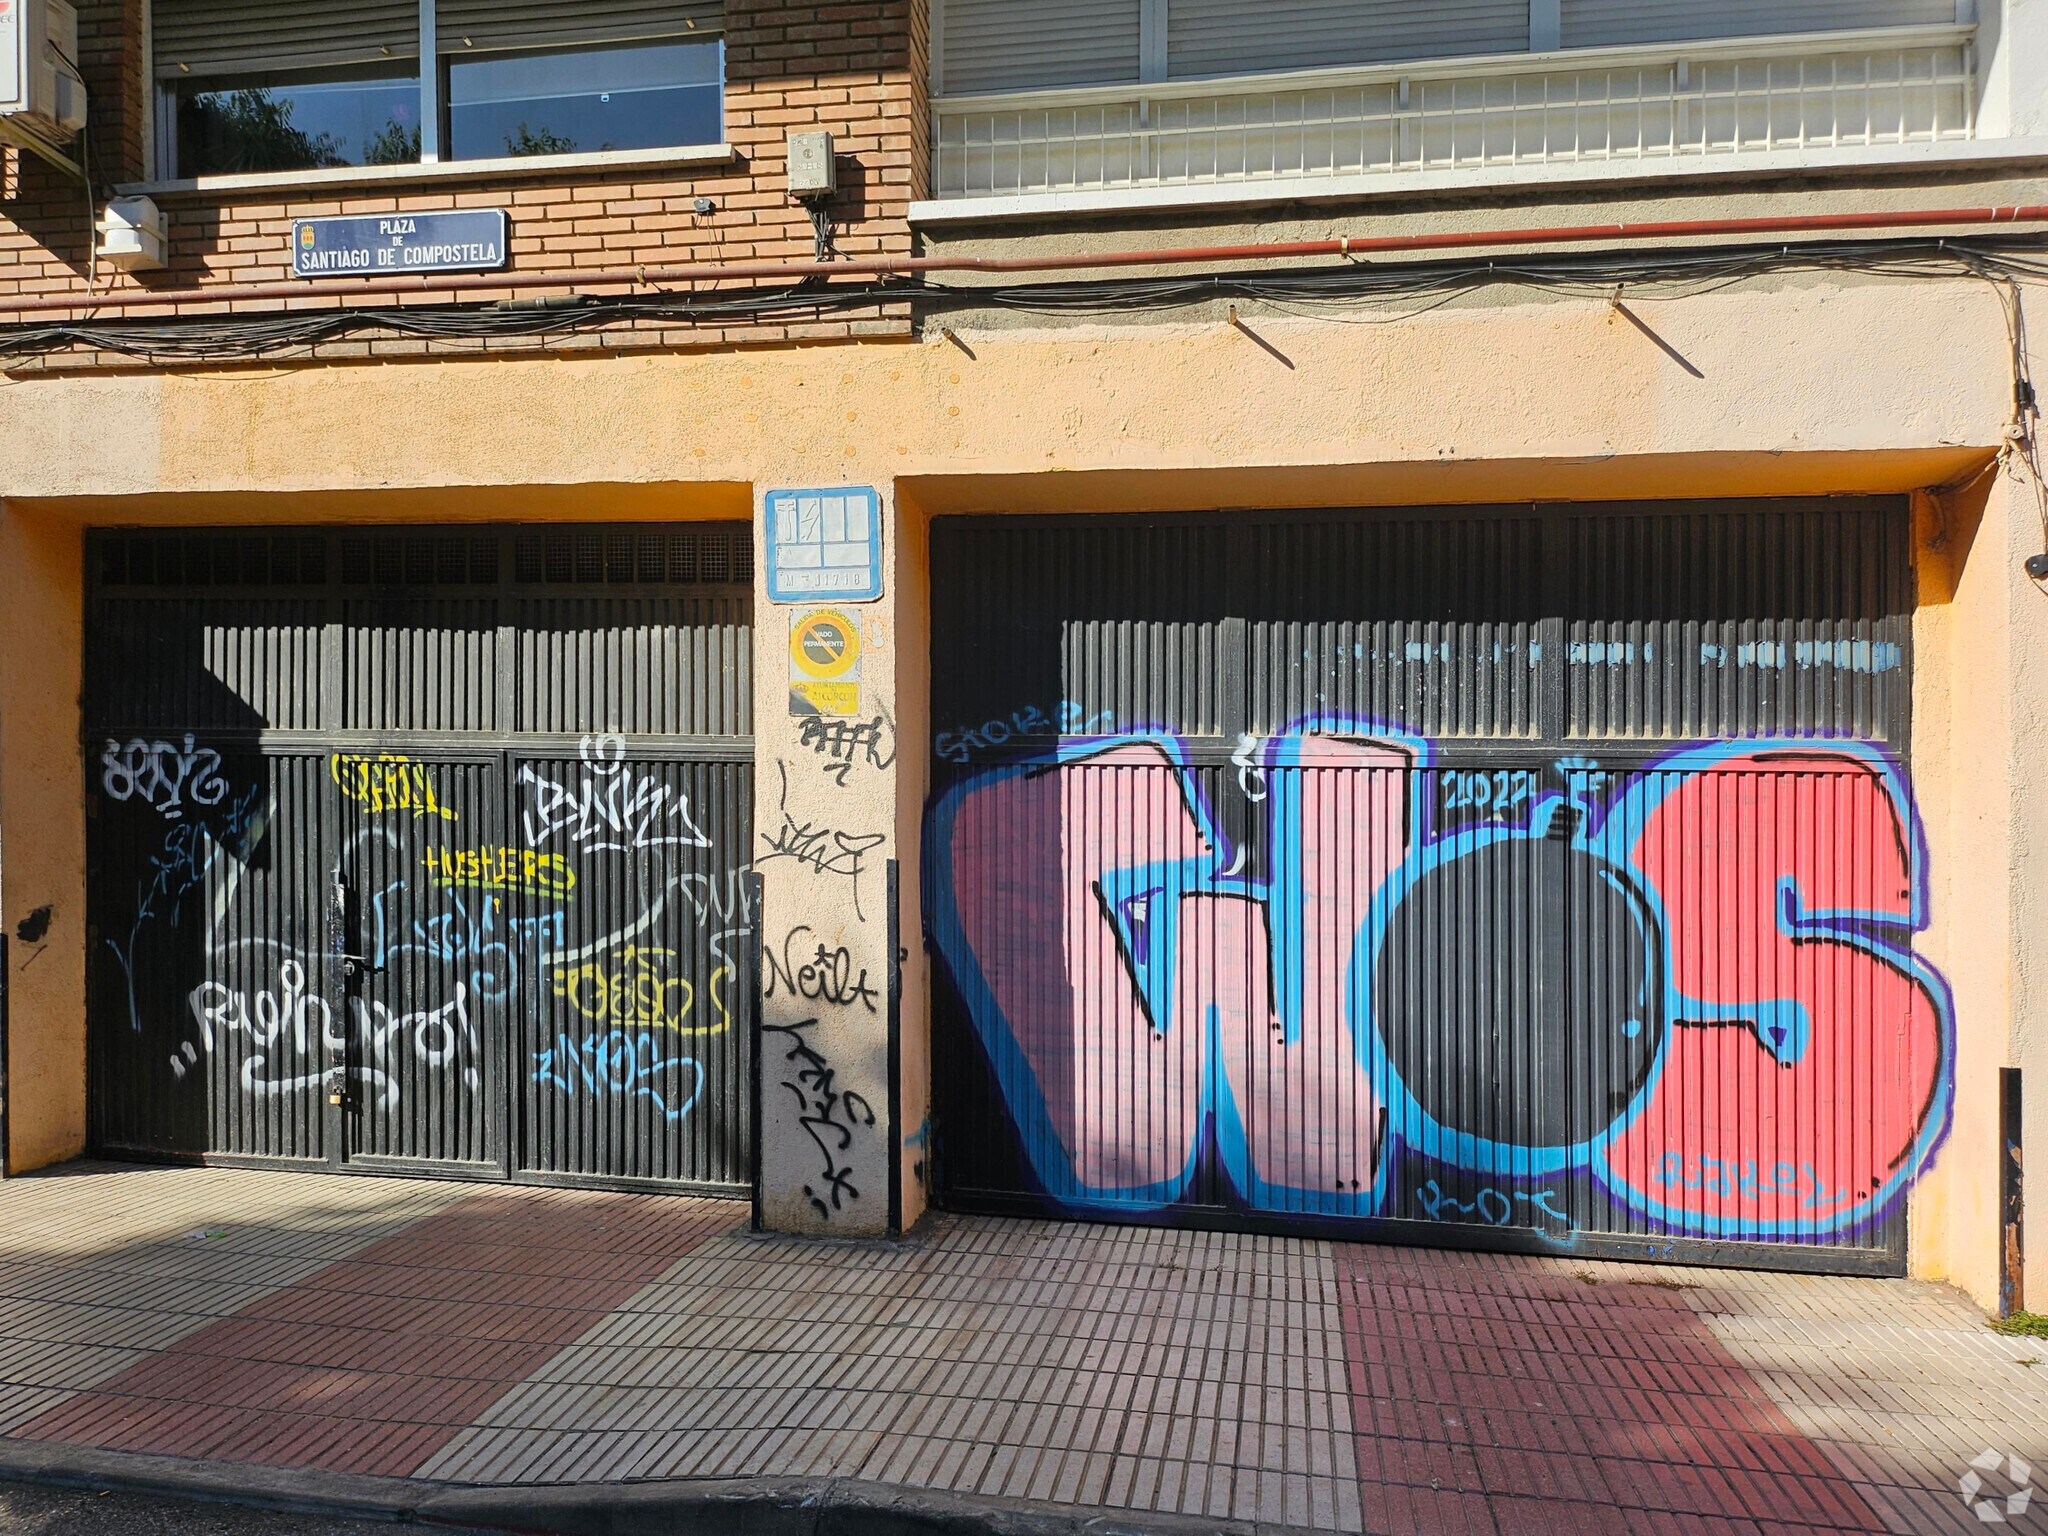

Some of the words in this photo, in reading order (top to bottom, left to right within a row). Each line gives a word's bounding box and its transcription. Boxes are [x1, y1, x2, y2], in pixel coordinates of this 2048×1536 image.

[380, 219, 416, 235] PLAZA
[392, 236, 404, 247] DE
[301, 249, 370, 270] SANTIAGO
[378, 248, 396, 266] DE
[404, 242, 497, 265] COMPOSTELA
[794, 610, 814, 630] SALIDA
[827, 609, 857, 632] VEHICULOS
[816, 630, 833, 638] VADO
[804, 640, 844, 648] PERMANENTE
